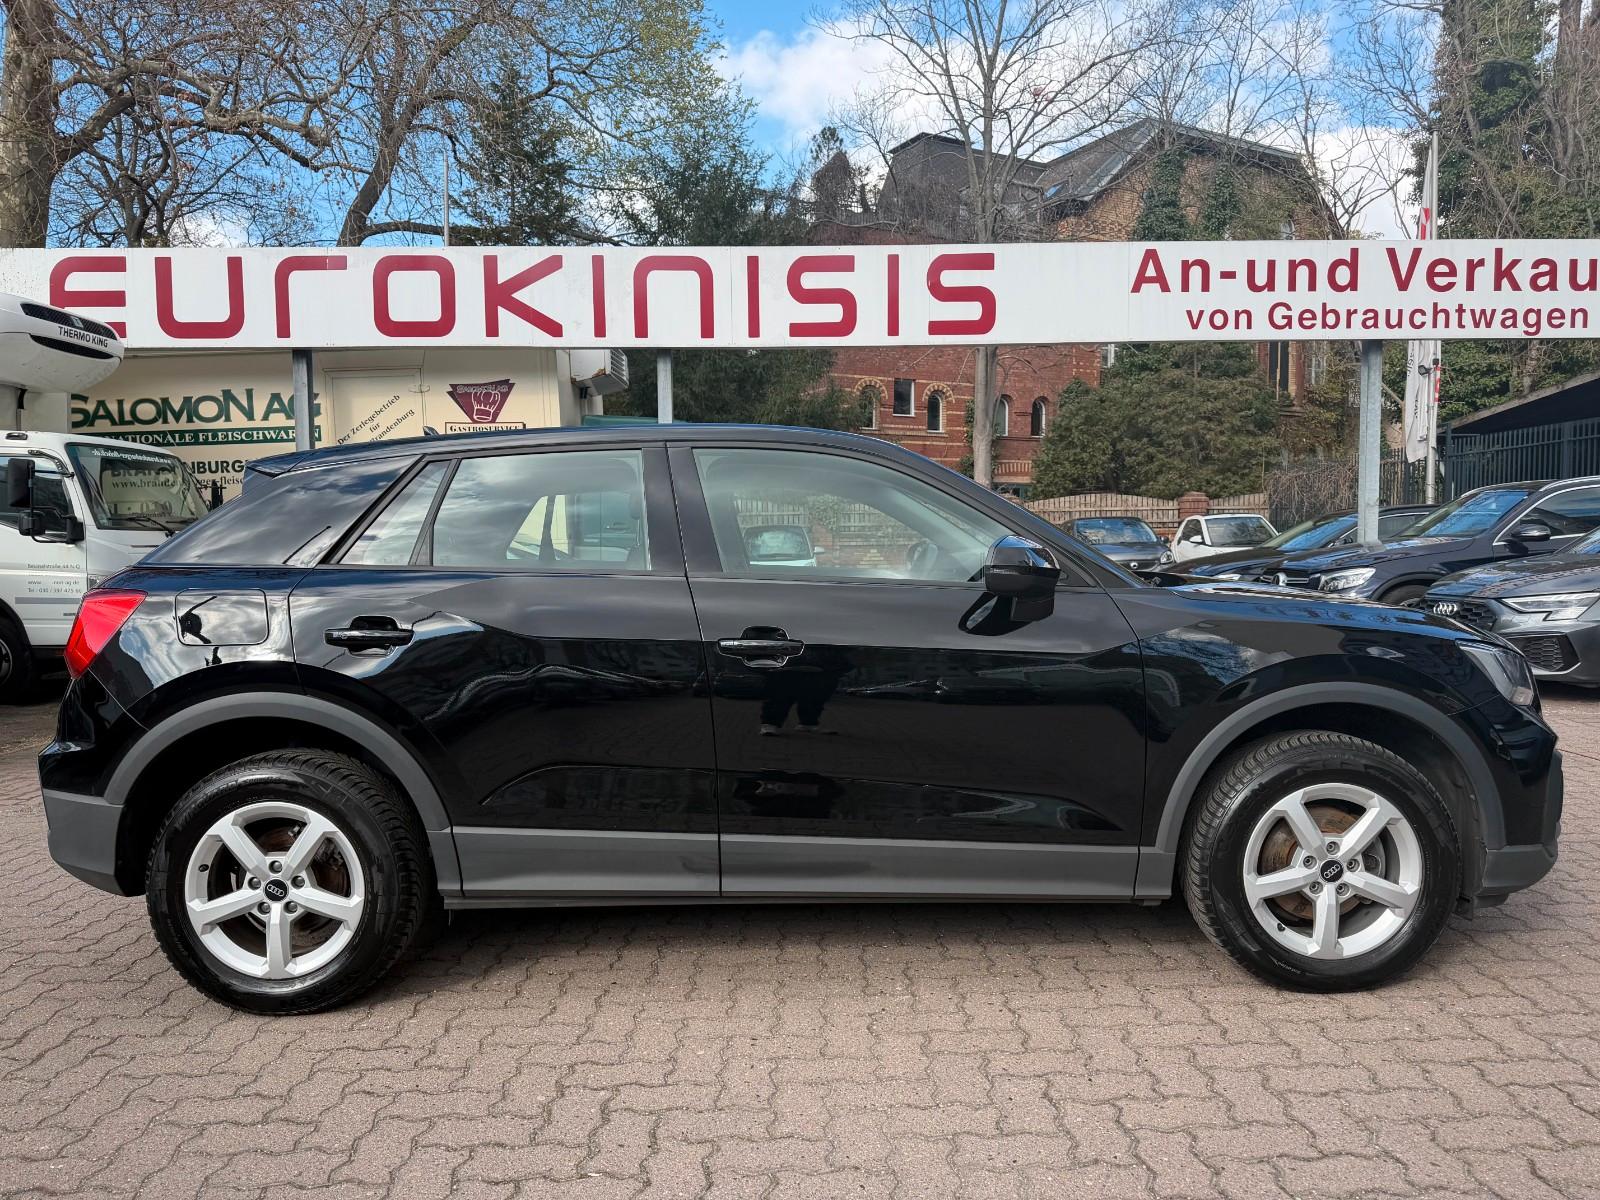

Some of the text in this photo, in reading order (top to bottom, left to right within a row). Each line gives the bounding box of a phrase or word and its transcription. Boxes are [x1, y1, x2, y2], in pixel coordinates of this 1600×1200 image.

[1130, 247, 1598, 293] An-und Verkau
[1186, 302, 1589, 336] von Gebrauchtwagen
[58, 326, 108, 348] THERMO KING
[70, 389, 255, 429] SALOMON
[336, 394, 401, 445] Der Zerlegebetrieb
[199, 428, 320, 442] FLEISCHWARN
[368, 421, 381, 434] für
